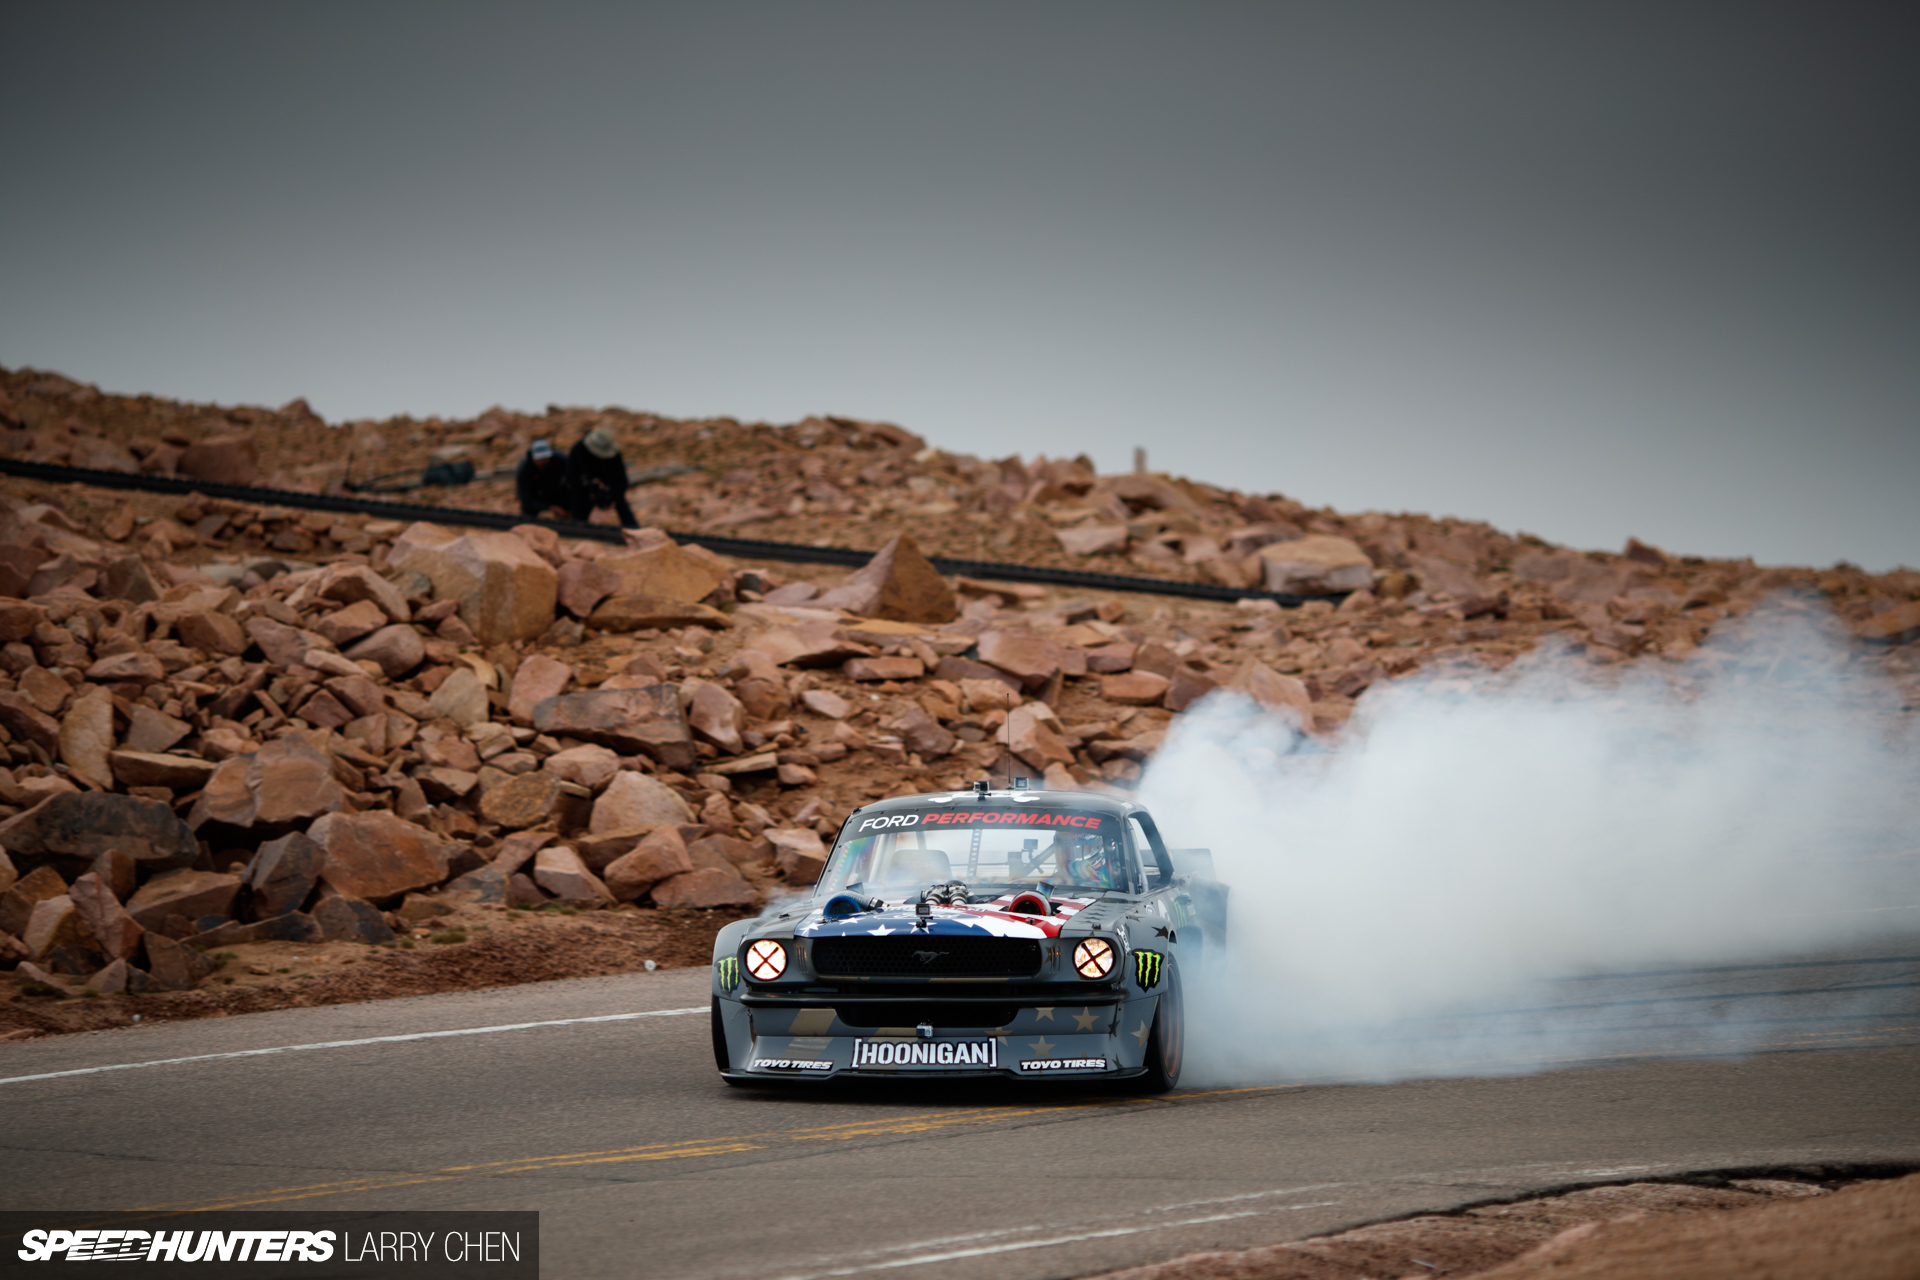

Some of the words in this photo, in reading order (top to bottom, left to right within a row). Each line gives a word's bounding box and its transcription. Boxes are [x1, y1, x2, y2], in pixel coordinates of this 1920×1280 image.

[858, 814, 919, 833] FORD
[921, 812, 1102, 830] PERFORMANCE
[753, 1059, 791, 1068] TOYO
[791, 1060, 833, 1070] TIRES
[1021, 1060, 1062, 1070] TOYO
[1062, 1059, 1106, 1069] TIRES
